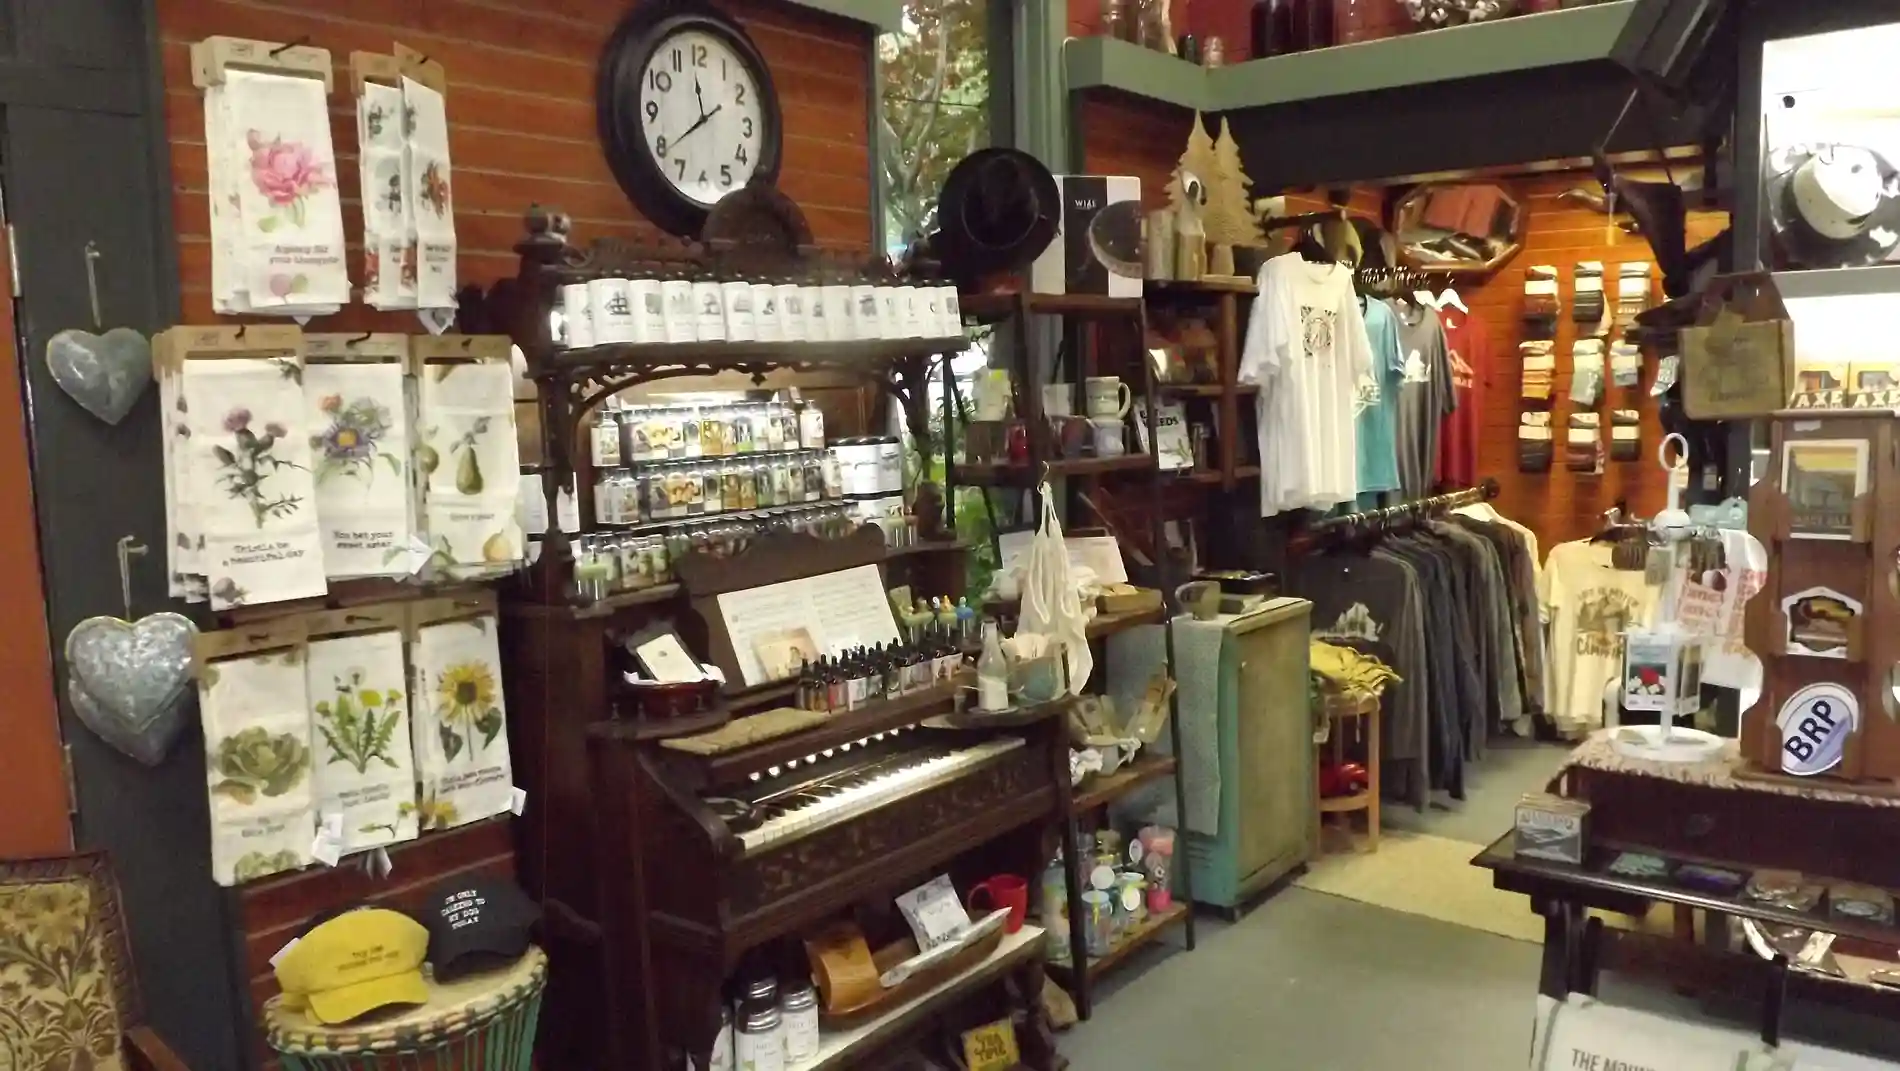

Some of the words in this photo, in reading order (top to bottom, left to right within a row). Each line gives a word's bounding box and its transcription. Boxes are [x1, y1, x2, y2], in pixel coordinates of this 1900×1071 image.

[672, 48, 683, 73] 11
[691, 43, 707, 68] 12
[649, 68, 673, 93] 10
[721, 58, 727, 82] 1
[734, 83, 746, 106] 2
[645, 100, 659, 124] 9
[741, 117, 753, 139] 3
[656, 135, 668, 159] 8
[735, 143, 748, 166] 4
[674, 158, 686, 181] 7
[719, 164, 732, 187] 5
[1795, 390, 1843, 409] AXE
[1784, 700, 1836, 763] BRP
[457, 890, 477, 899] ONLY
[463, 908, 480, 918] DOG
[1571, 1047, 1601, 1071] THE
